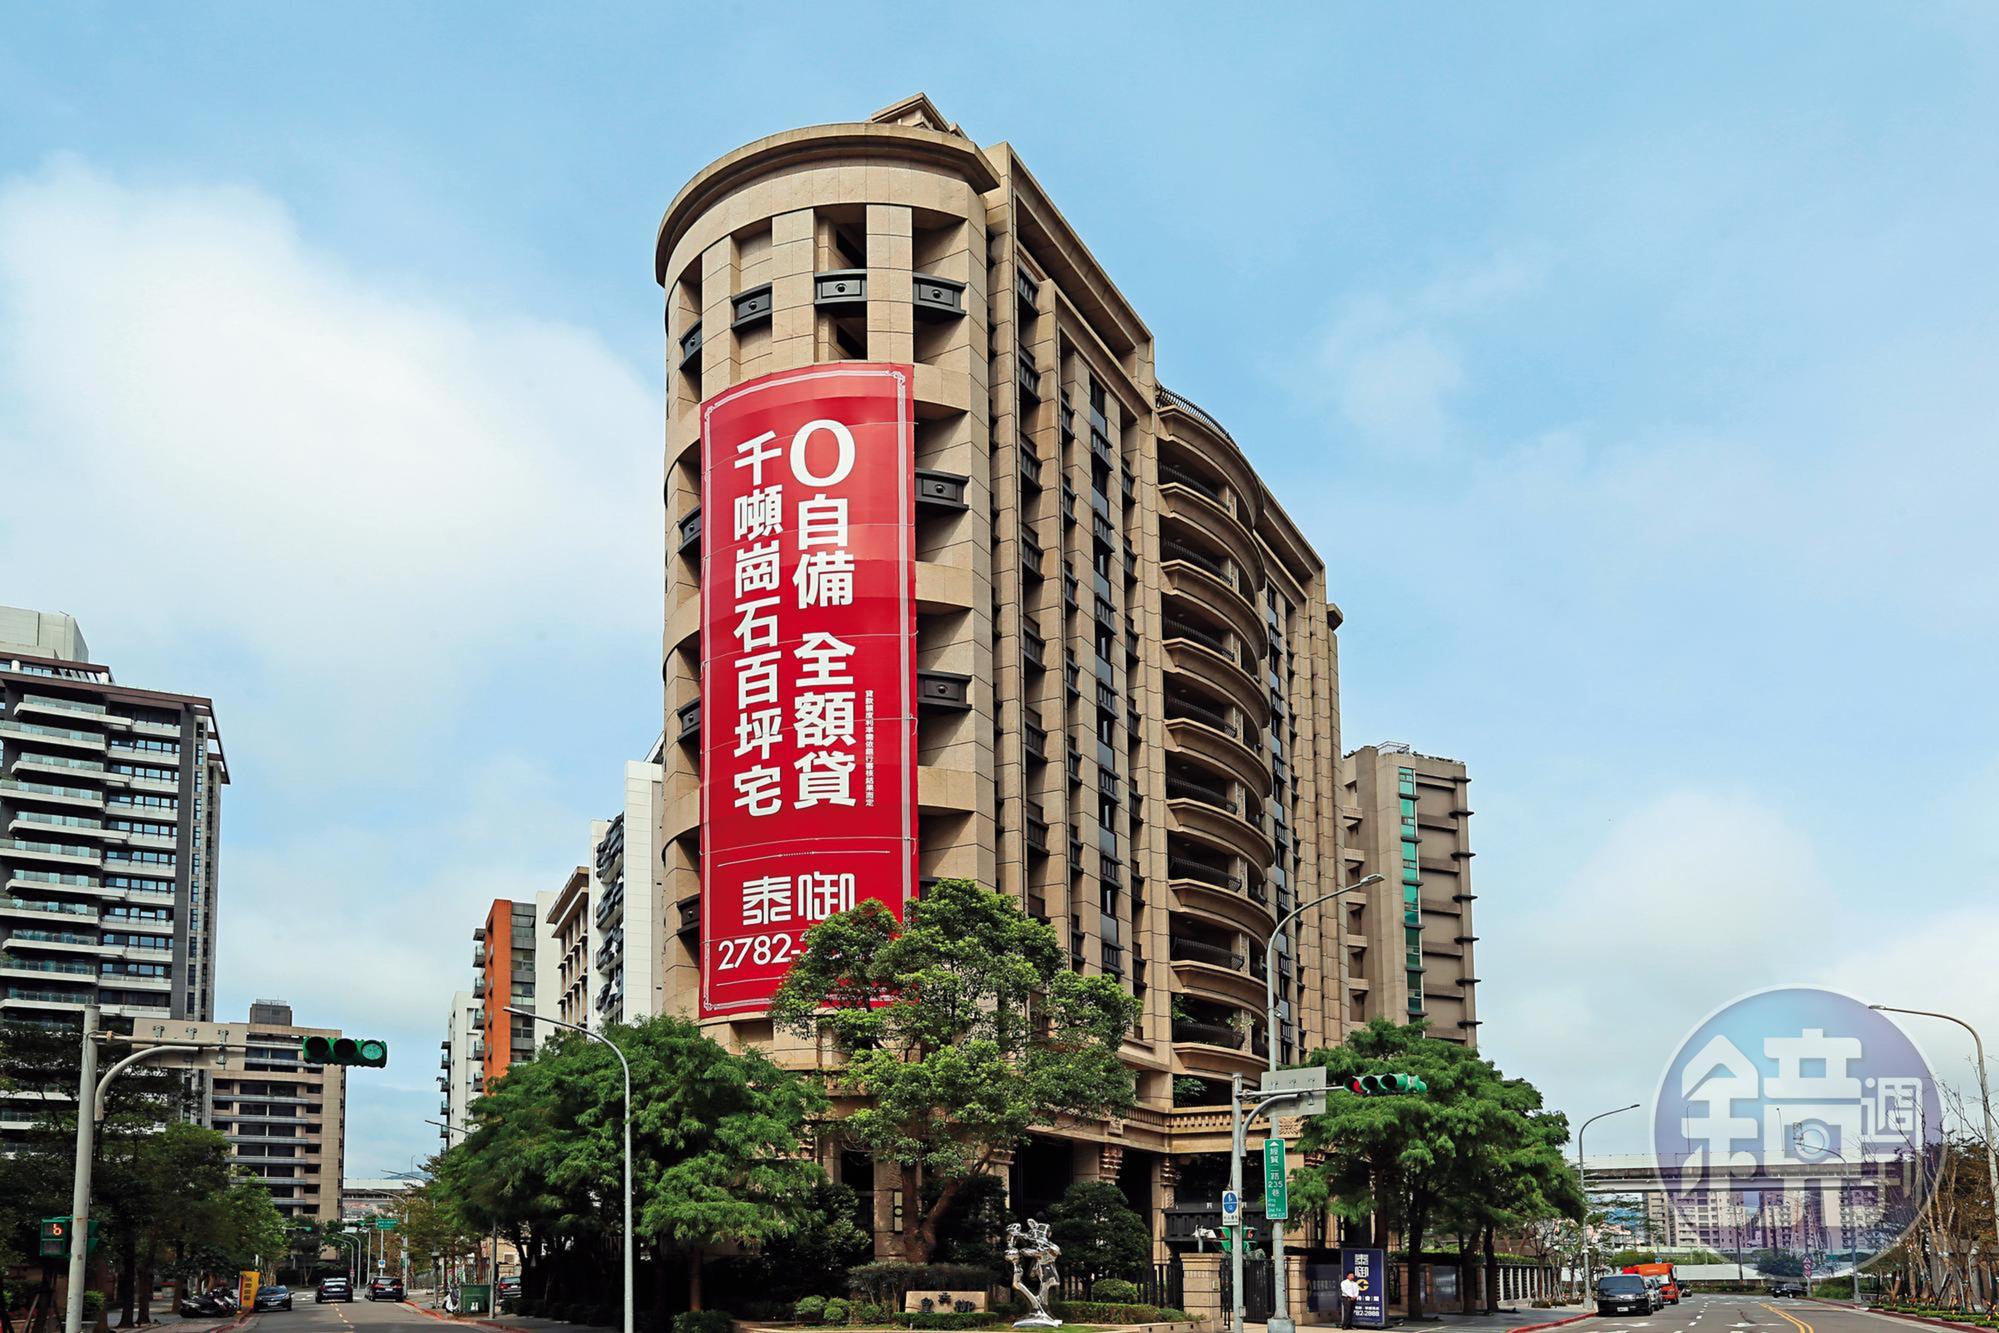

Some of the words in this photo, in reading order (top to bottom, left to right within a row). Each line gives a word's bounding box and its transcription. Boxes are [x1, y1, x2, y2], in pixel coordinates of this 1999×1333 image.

[734, 430, 783, 817] 千噸崗石百坪宅
[793, 631, 856, 810] 全額貸
[742, 871, 855, 925] 泰御
